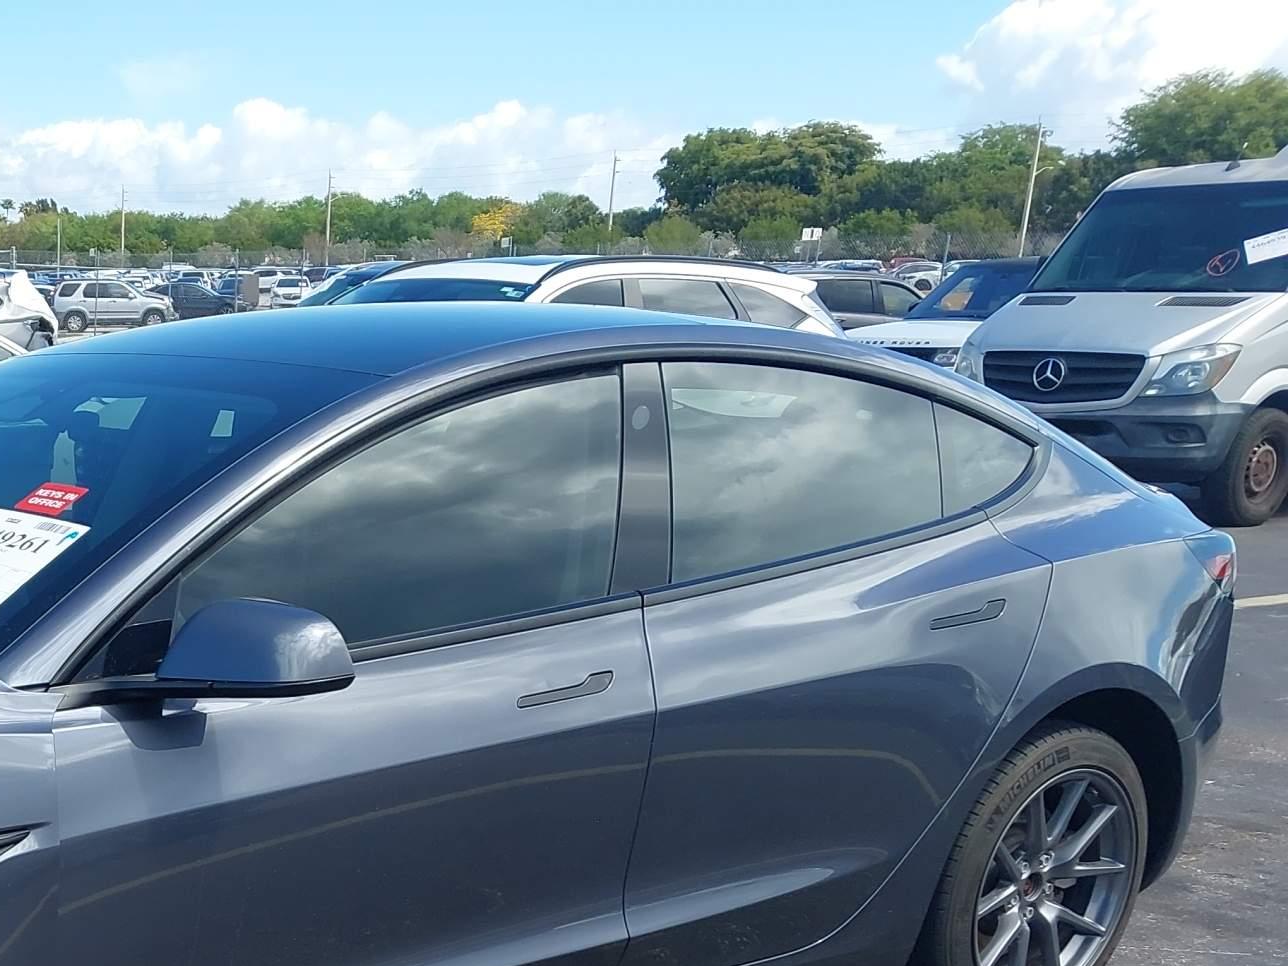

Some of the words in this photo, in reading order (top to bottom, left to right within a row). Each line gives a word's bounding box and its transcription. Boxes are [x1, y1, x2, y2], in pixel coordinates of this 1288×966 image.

[34, 488, 66, 499] KEYS
[63, 492, 80, 501] IN
[27, 496, 66, 509] OFFICE
